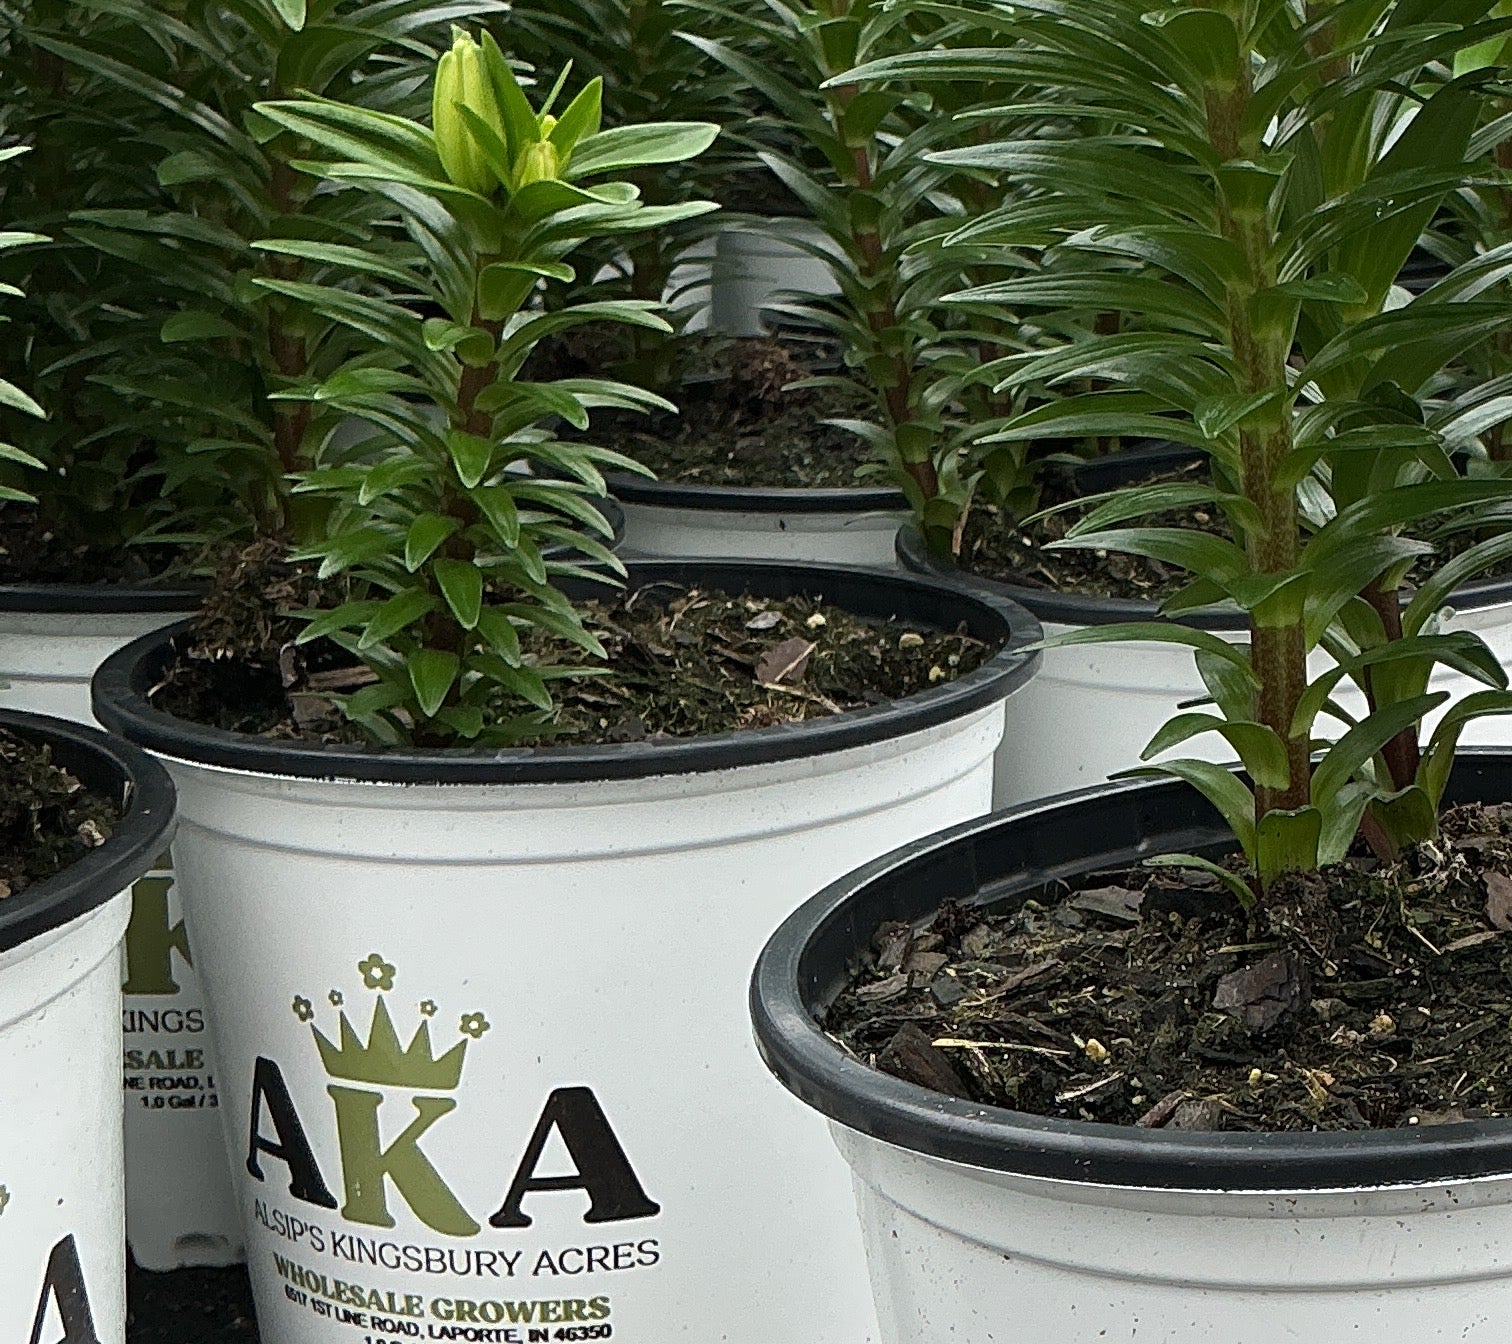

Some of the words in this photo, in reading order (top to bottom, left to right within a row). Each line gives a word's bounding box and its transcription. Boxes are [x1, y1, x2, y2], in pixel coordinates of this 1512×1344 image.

[247, 1056, 661, 1238] AKA
[254, 1197, 325, 1253] ALSIP'S
[330, 1230, 524, 1278] KINGSBURY
[532, 1239, 660, 1277] ACRES
[273, 1251, 425, 1318] WHOLESALE
[430, 1295, 611, 1324] GROWERS
[310, 1297, 332, 1318] 1ST
[335, 1306, 368, 1329] LINE
[528, 1327, 549, 1344] IN
[553, 1323, 612, 1342] 46350
